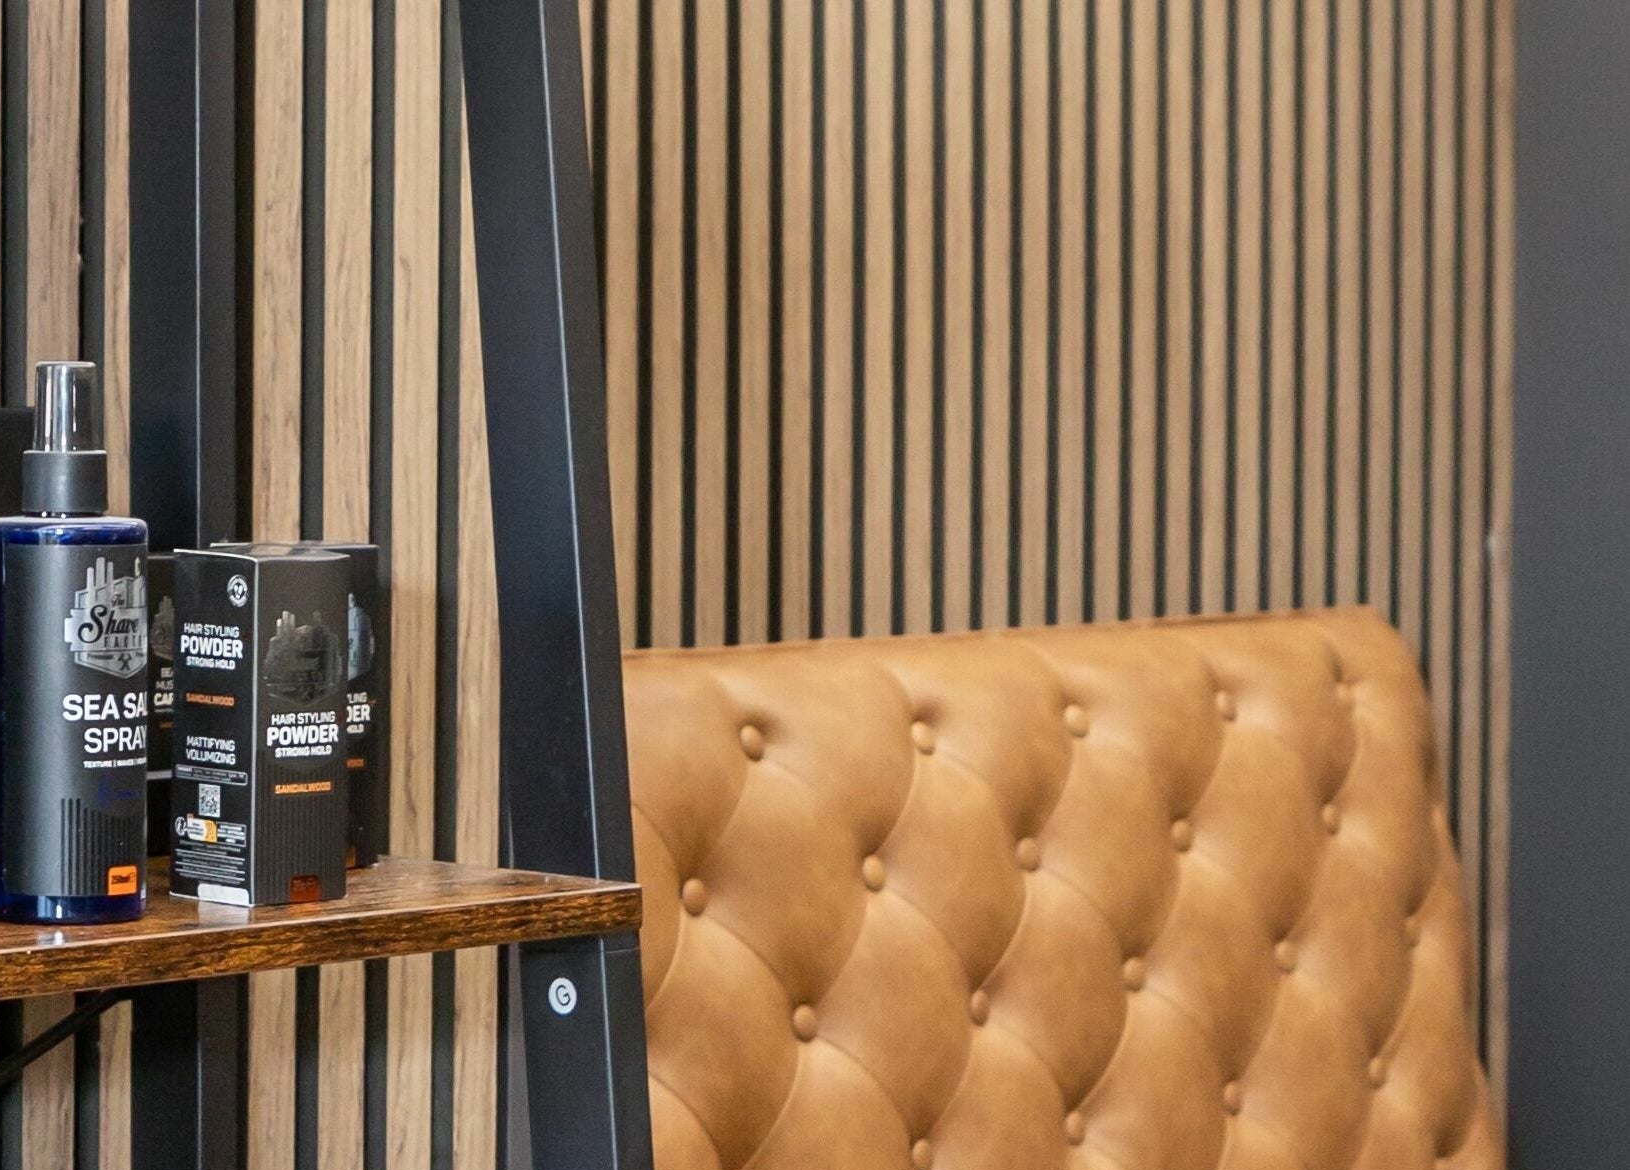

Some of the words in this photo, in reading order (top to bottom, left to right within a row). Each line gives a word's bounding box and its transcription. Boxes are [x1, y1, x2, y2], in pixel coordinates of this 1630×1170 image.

[183, 622, 203, 635] HAIR
[204, 624, 240, 637] STYLING
[180, 635, 243, 659] POWDER
[62, 694, 120, 721] SEA
[271, 714, 295, 726] HAIR
[297, 711, 336, 725] STYLING
[186, 736, 235, 751] MATTIFYING
[266, 724, 339, 746] POWDER
[186, 748, 236, 765] VOLUMIZING
